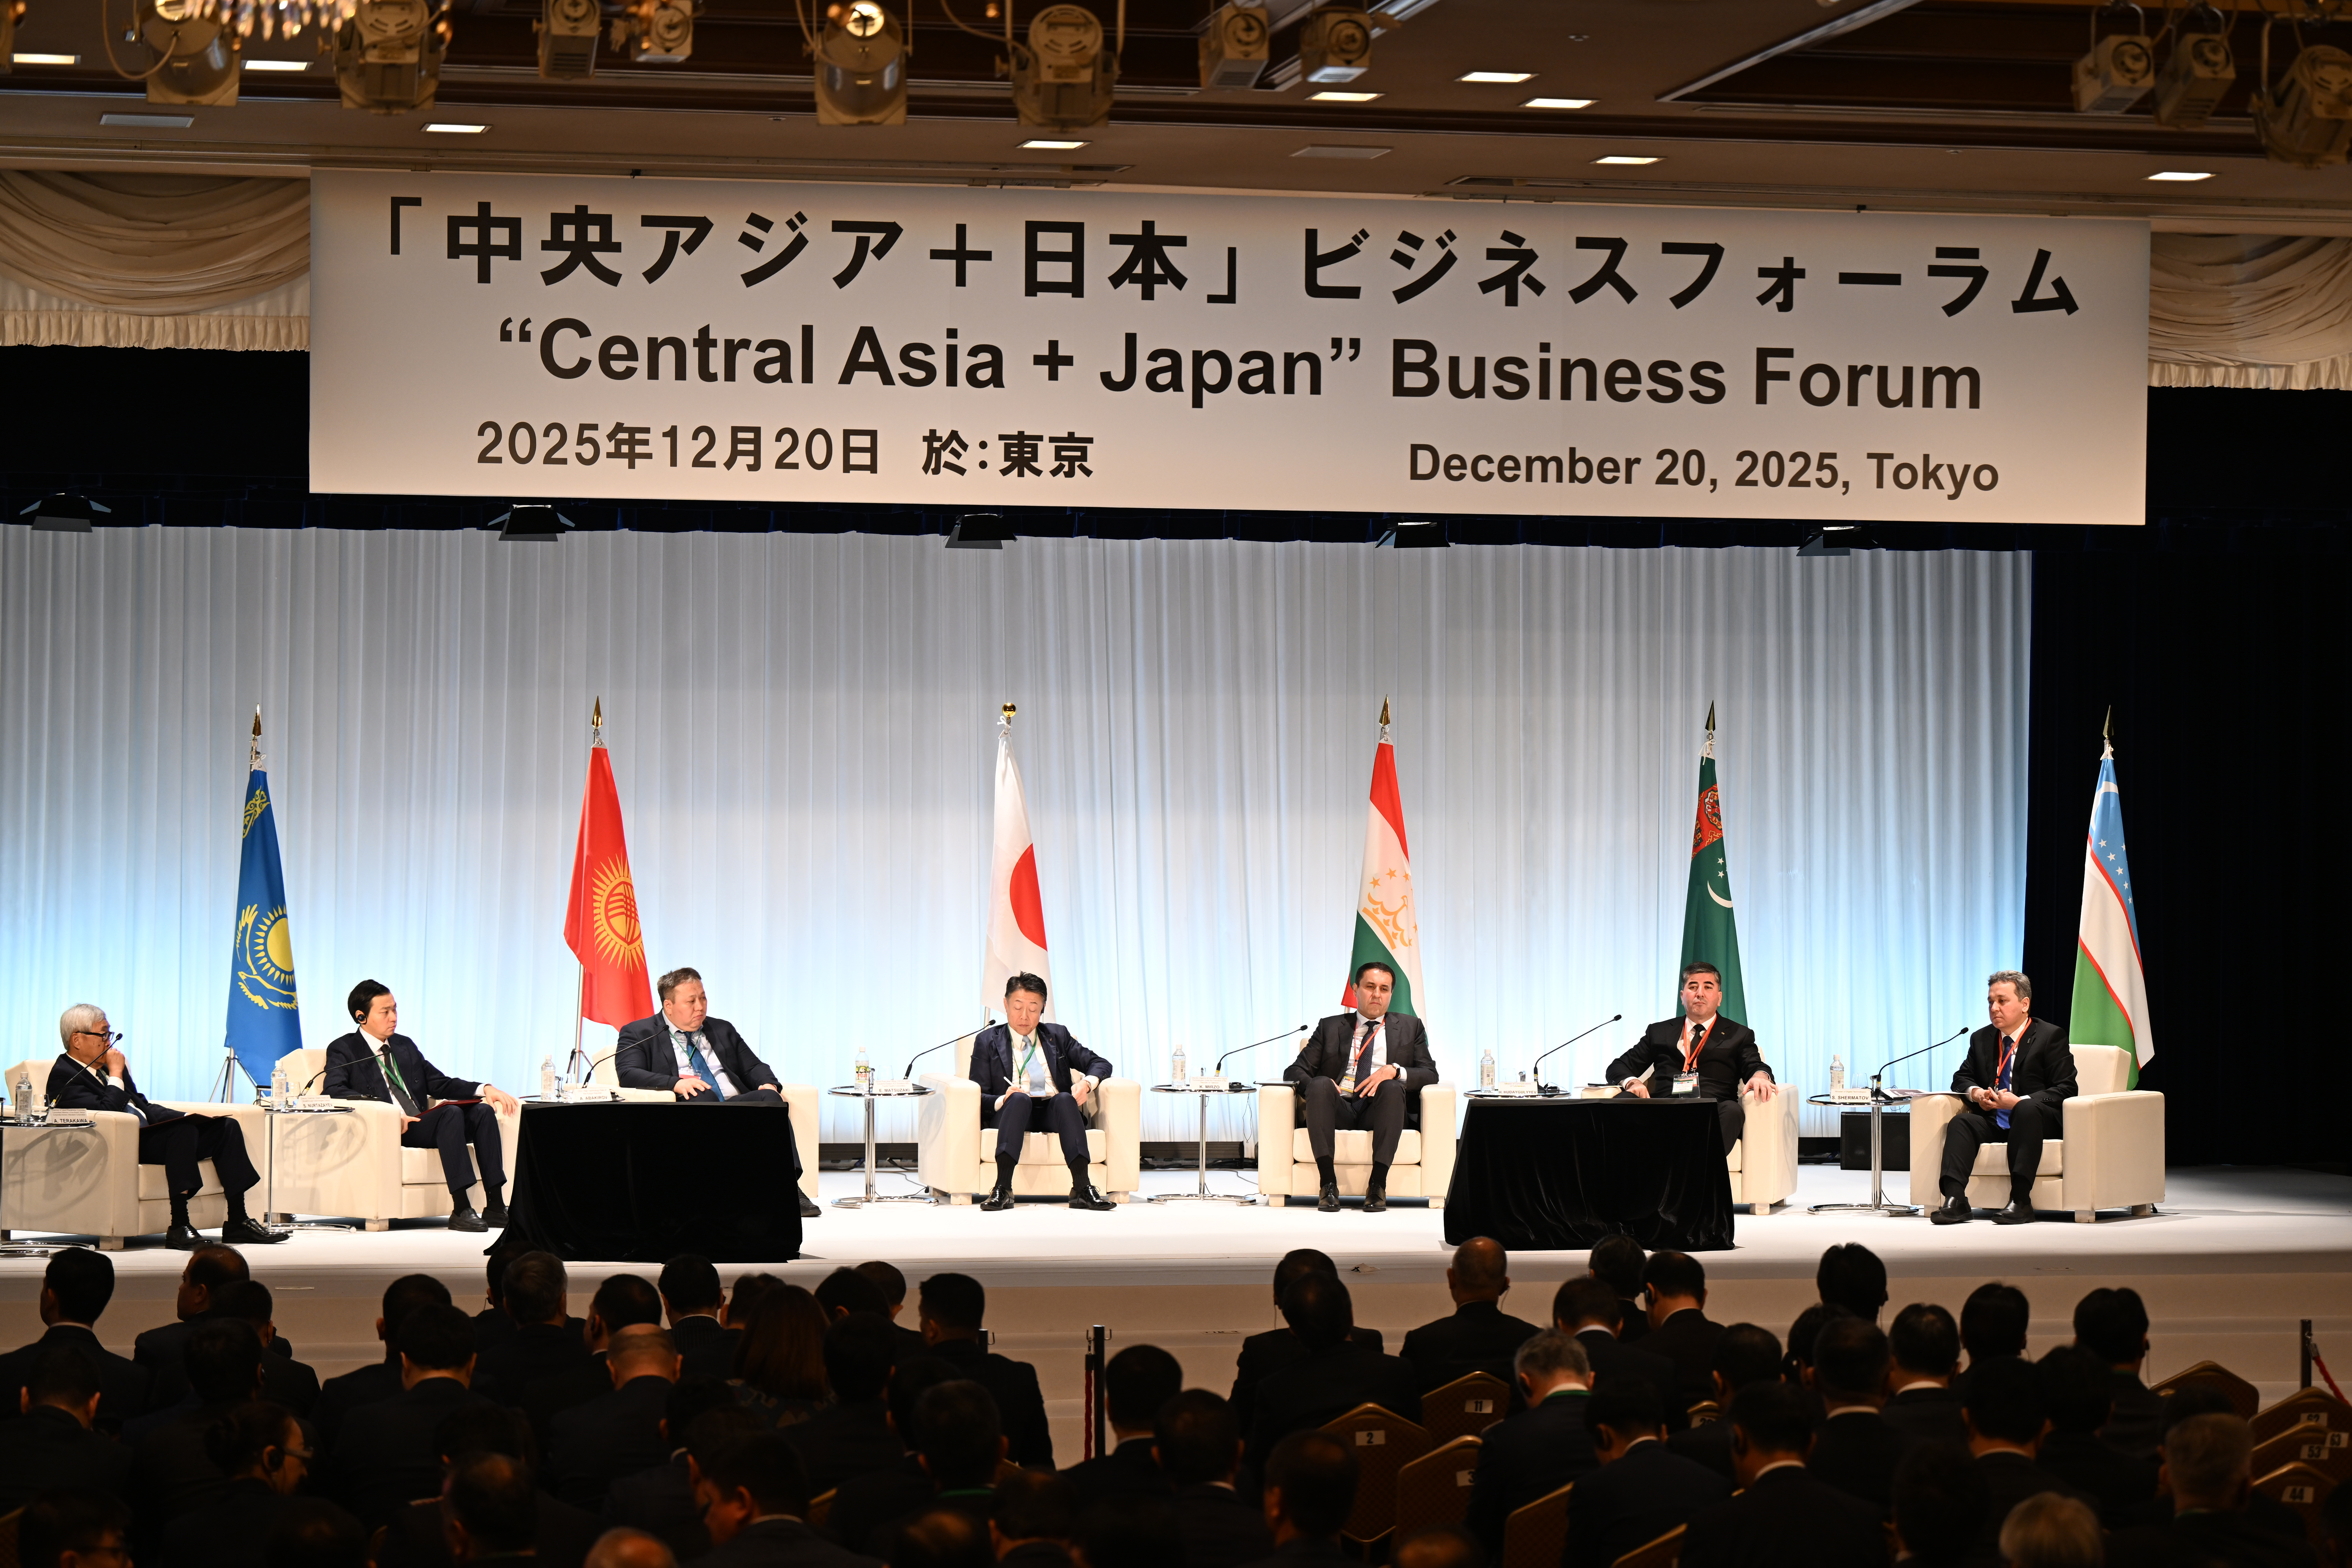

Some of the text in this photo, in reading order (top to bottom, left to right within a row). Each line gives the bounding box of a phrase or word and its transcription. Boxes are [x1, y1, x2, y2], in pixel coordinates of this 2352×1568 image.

[390, 196, 2079, 317] 「中央アジア＋日本」 ビジネスフォーラム
[500, 317, 1980, 409] “Central Asia + Japan” Business Forum
[477, 421, 1094, 478] 2025年12月20日 於：東京
[1410, 444, 1998, 500] December 20, 2025, Tokyo
[1474, 1400, 1483, 1412] 11
[1367, 1432, 1373, 1443] 2
[2308, 1446, 2322, 1458] 53
[2289, 1487, 2304, 1500] 44
